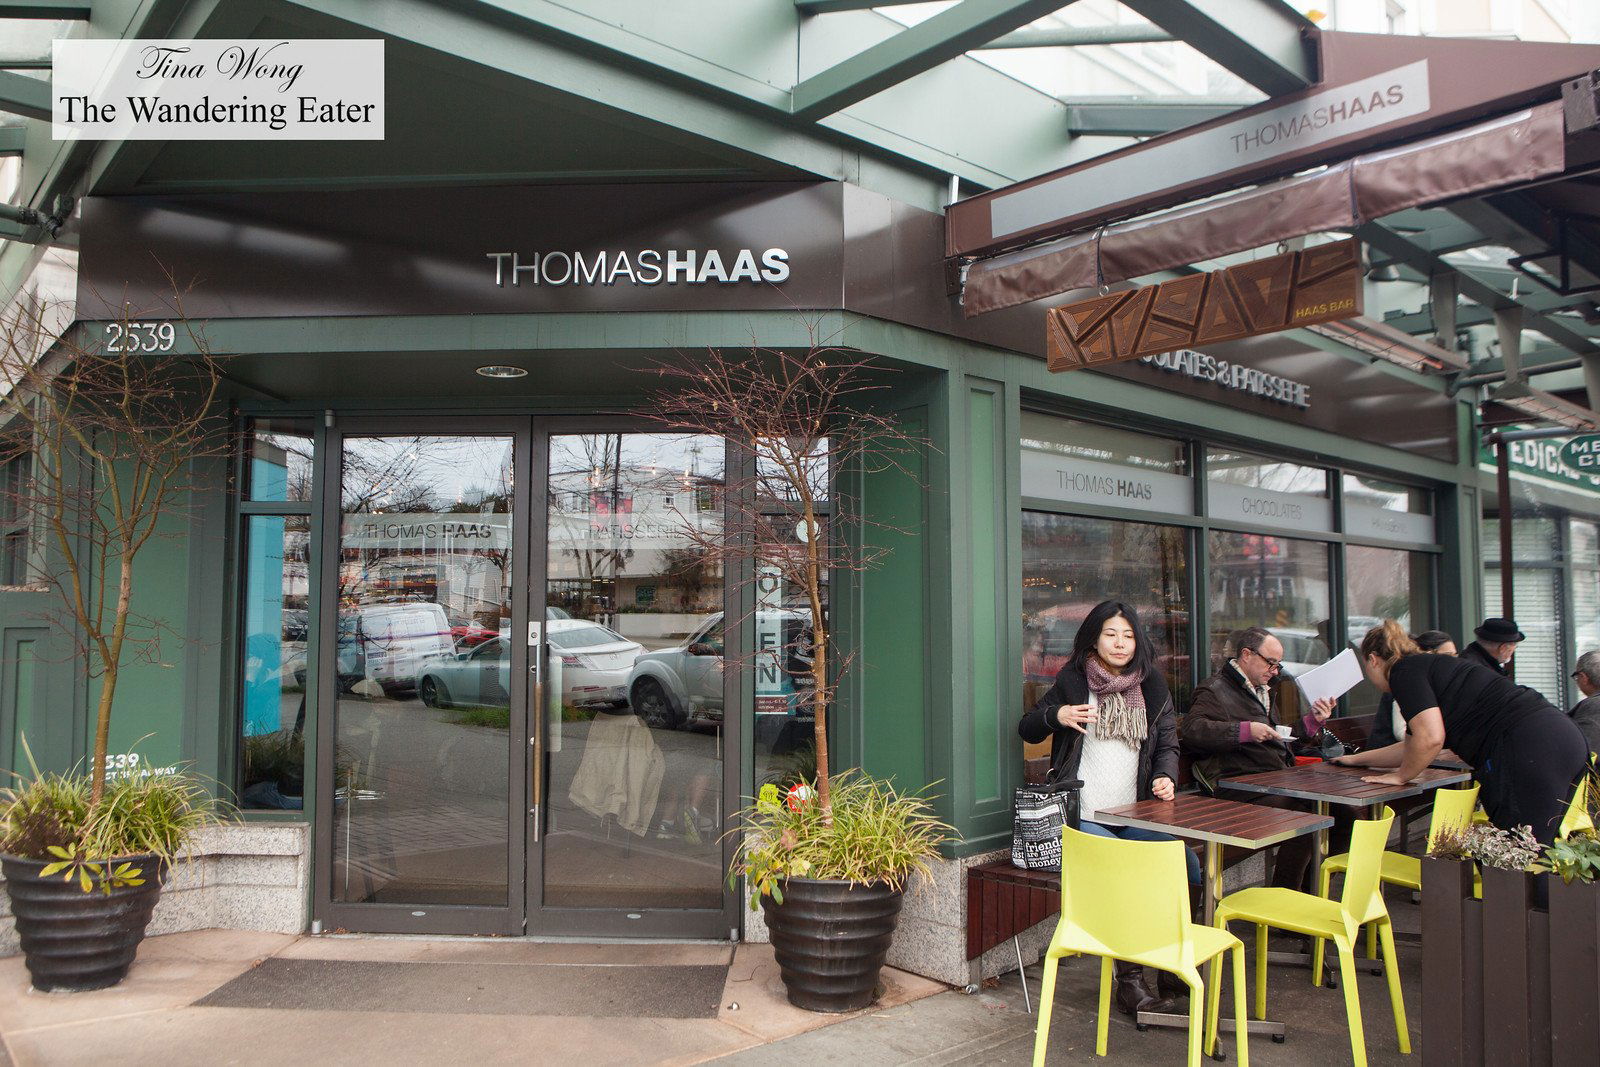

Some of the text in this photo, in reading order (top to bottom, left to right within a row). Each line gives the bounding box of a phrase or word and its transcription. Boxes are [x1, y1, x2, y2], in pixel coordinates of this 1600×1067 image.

[1295, 299, 1355, 318] HAAS BAR
[106, 322, 175, 352] 2539
[1231, 364, 1311, 408] PATISSERIE
[1056, 470, 1152, 501] THOMAS HAAS
[1242, 497, 1302, 521] CHOCOLATES
[364, 523, 492, 539] THOMAS HAAS
[90, 753, 140, 772] 539
[1040, 847, 1062, 857] more
[1028, 857, 1062, 869] money
